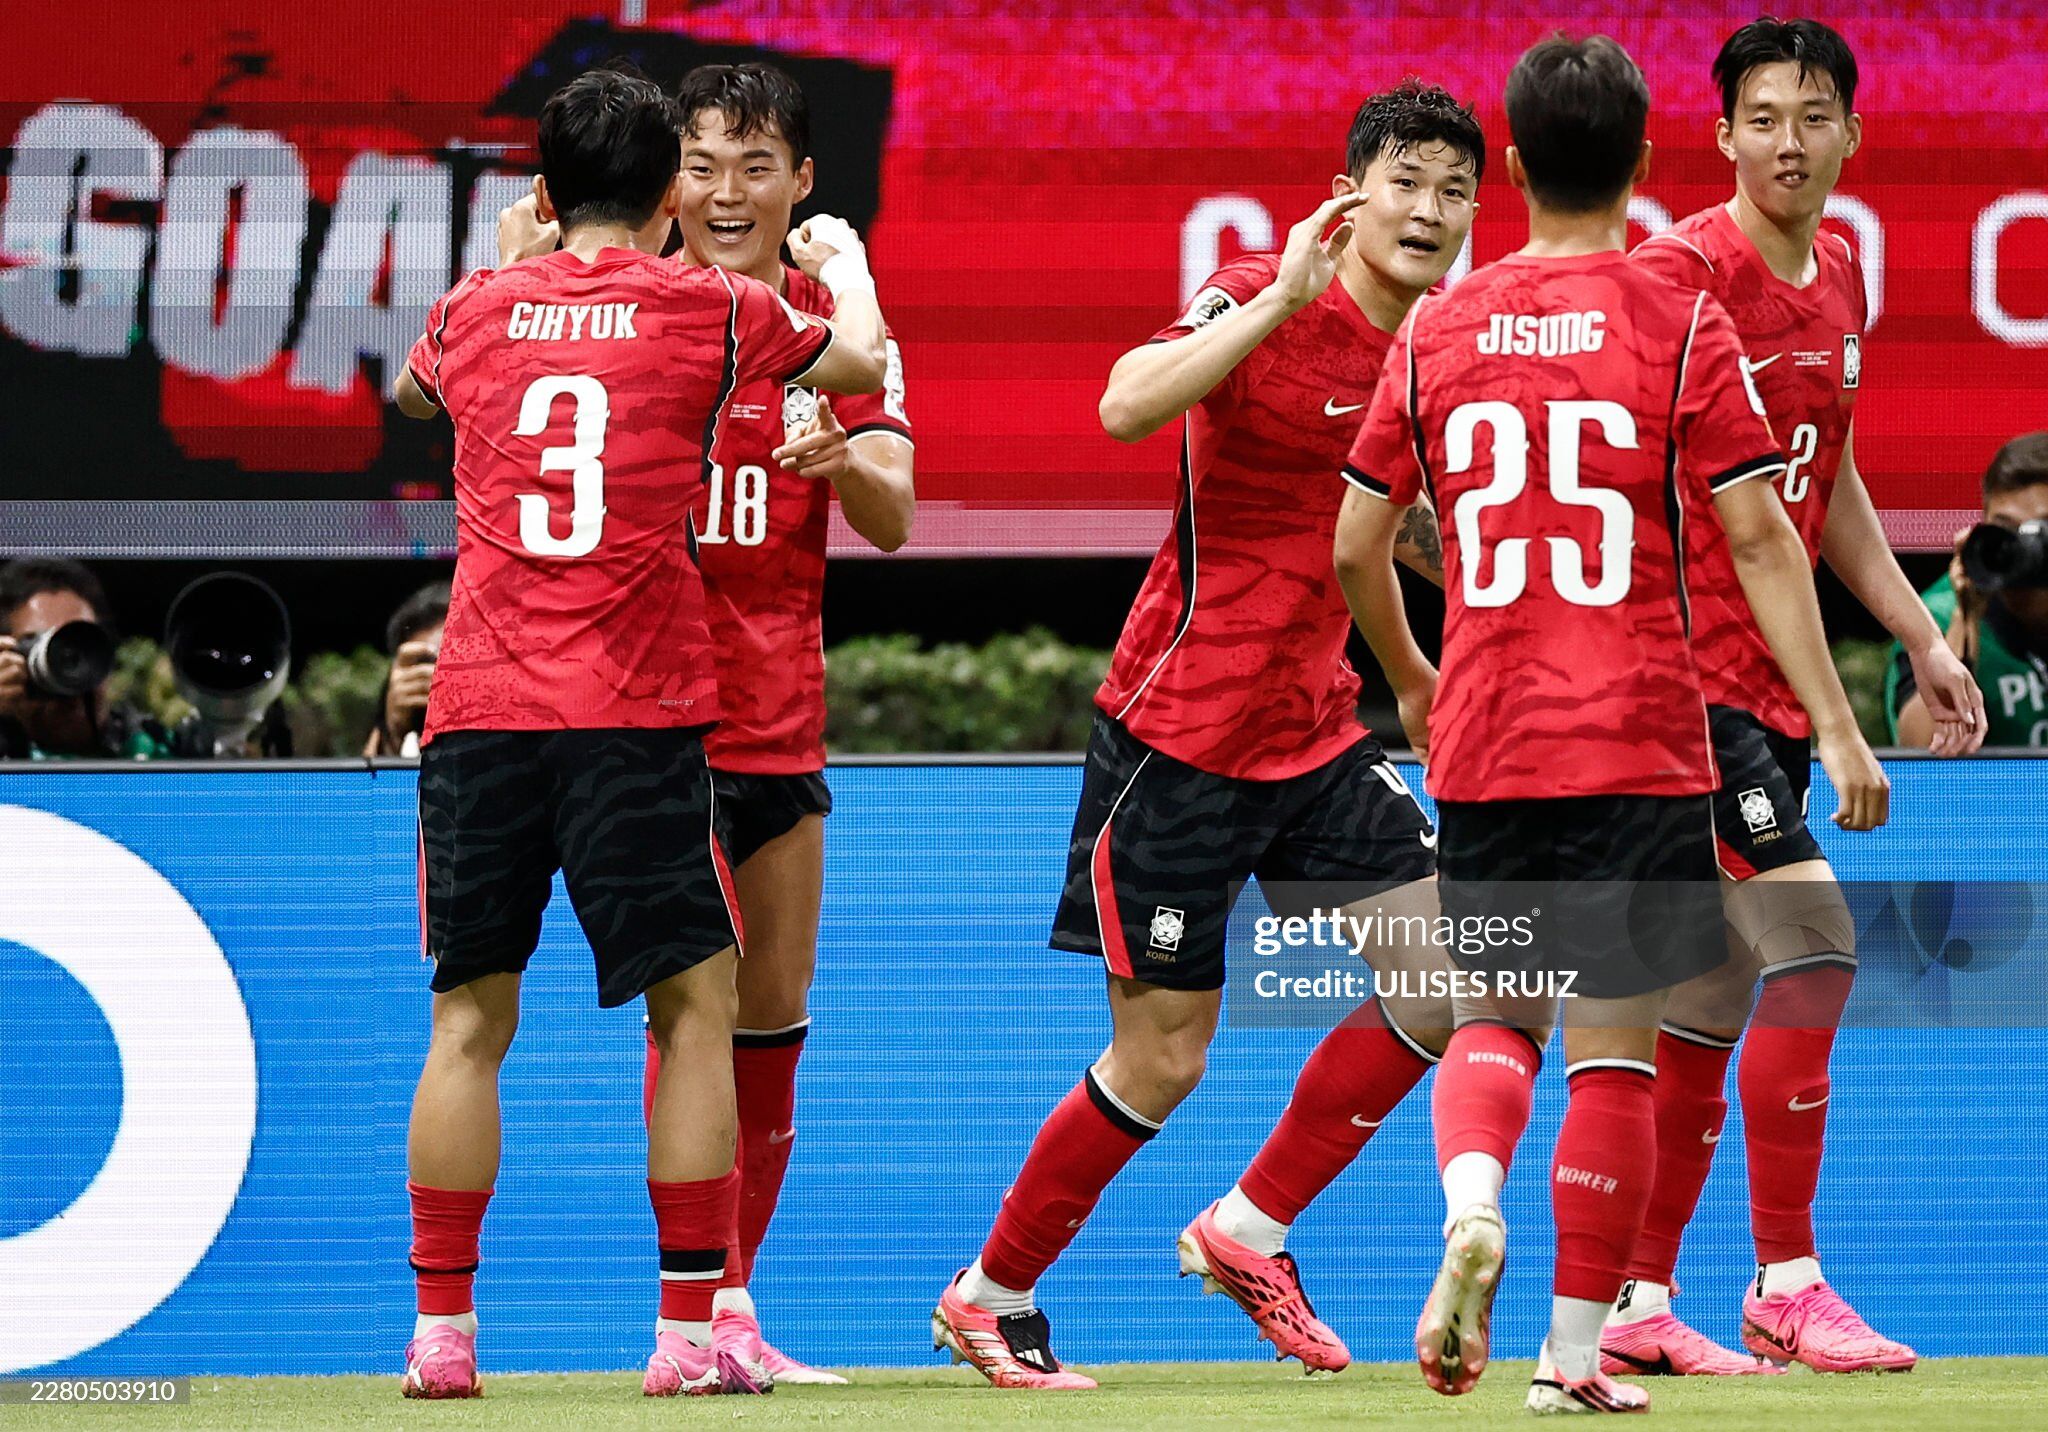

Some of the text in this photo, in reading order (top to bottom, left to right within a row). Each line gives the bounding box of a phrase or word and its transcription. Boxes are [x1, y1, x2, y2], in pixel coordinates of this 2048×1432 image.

[507, 301, 639, 342] GIHYUK
[1475, 309, 1607, 358] JISUNG
[510, 374, 611, 558] 3
[1782, 423, 1818, 503] 2
[696, 464, 769, 547] 18
[1444, 400, 1641, 608] 25
[1145, 949, 1177, 963] KOREA
[1556, 1163, 1619, 1195] KOREA
